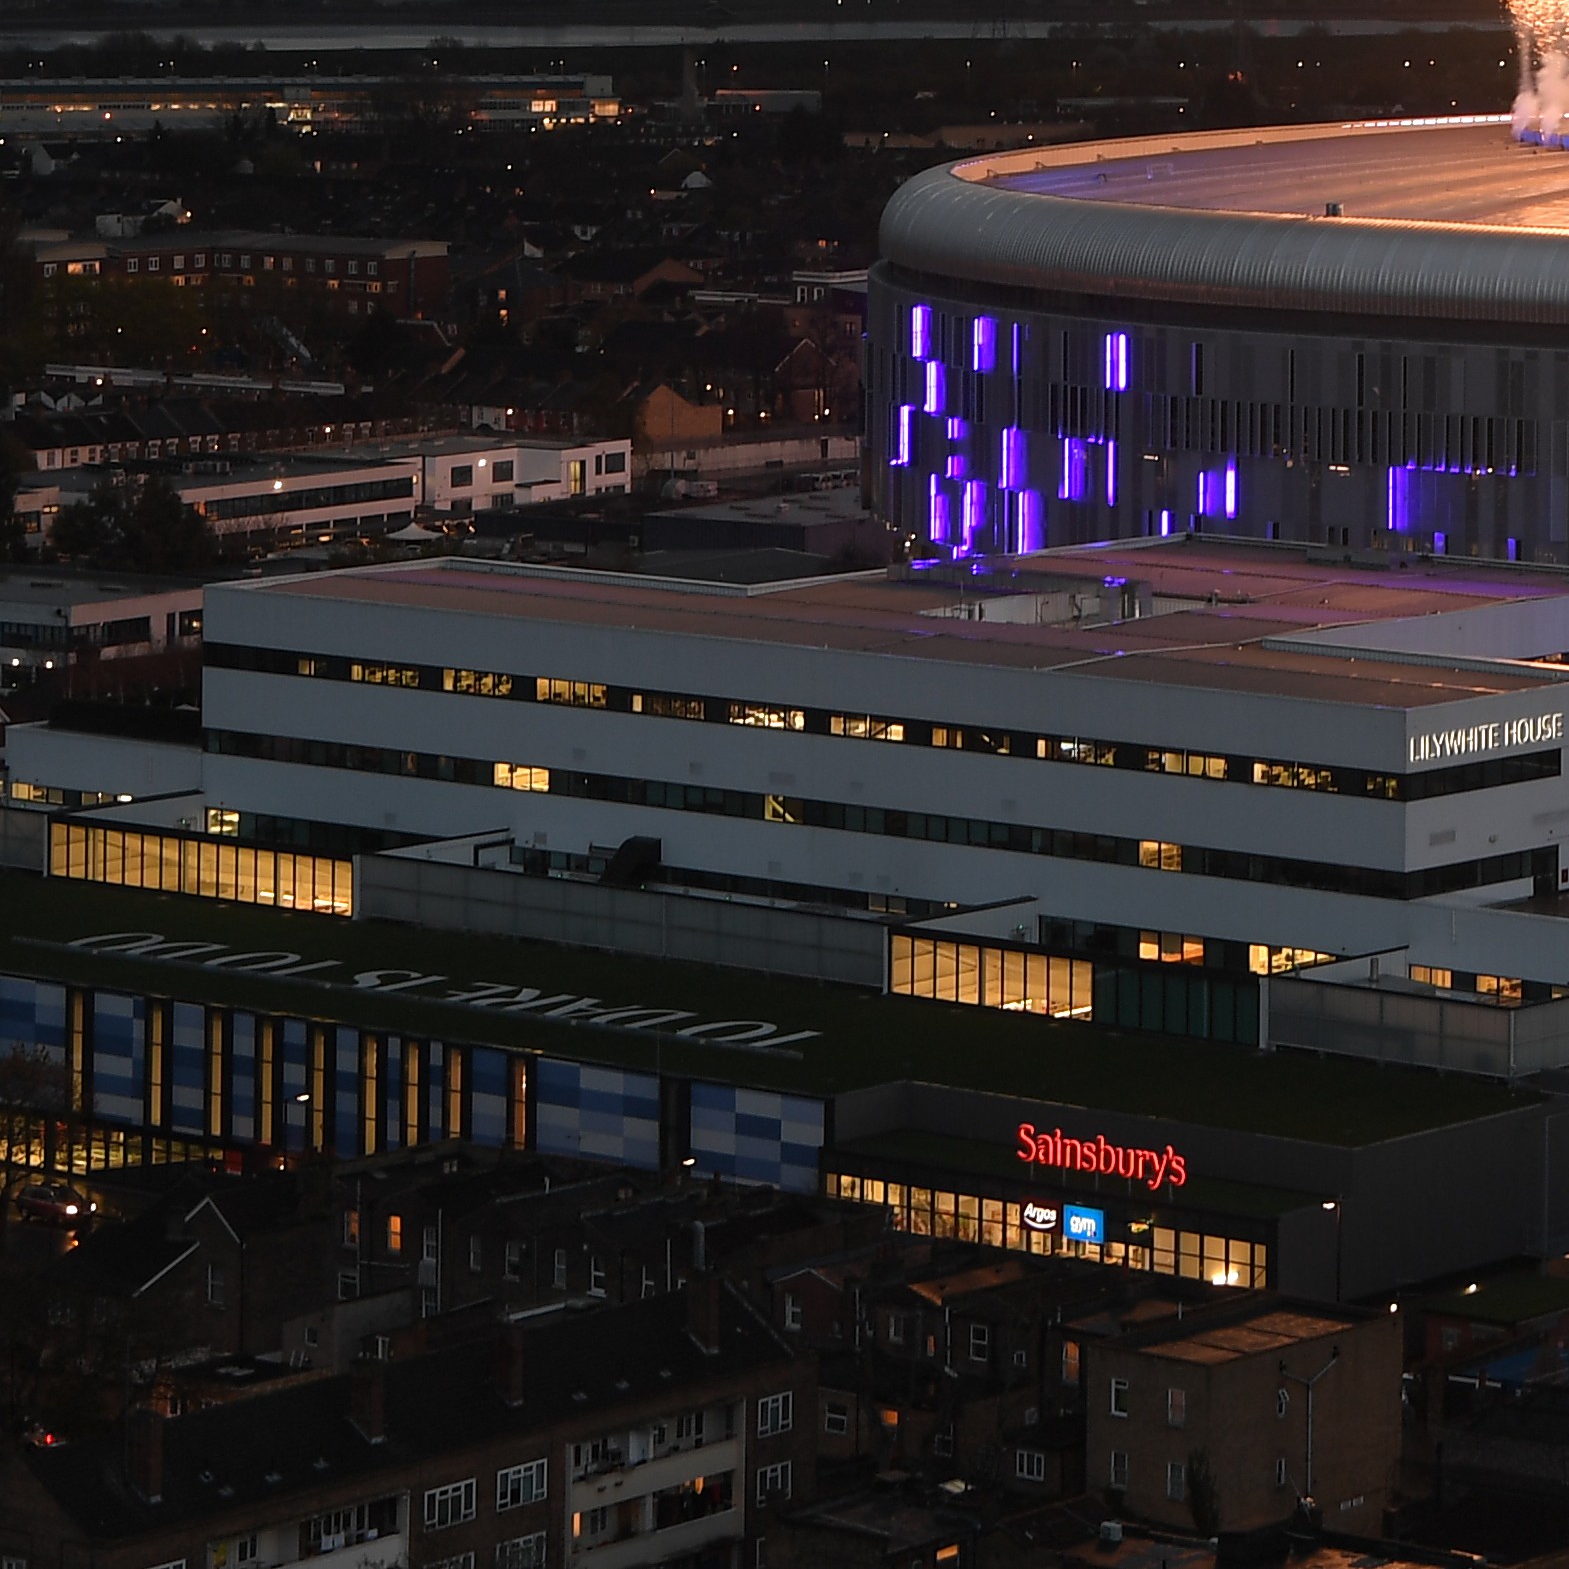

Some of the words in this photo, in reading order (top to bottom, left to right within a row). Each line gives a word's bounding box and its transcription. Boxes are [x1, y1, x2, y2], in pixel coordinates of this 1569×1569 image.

[1410, 722, 1500, 763] LILYWHITE
[1504, 712, 1563, 747] HOUSE
[1017, 1122, 1186, 1190] Sainsbury's
[1024, 1202, 1057, 1222] Argos
[1070, 1215, 1096, 1234] gym
